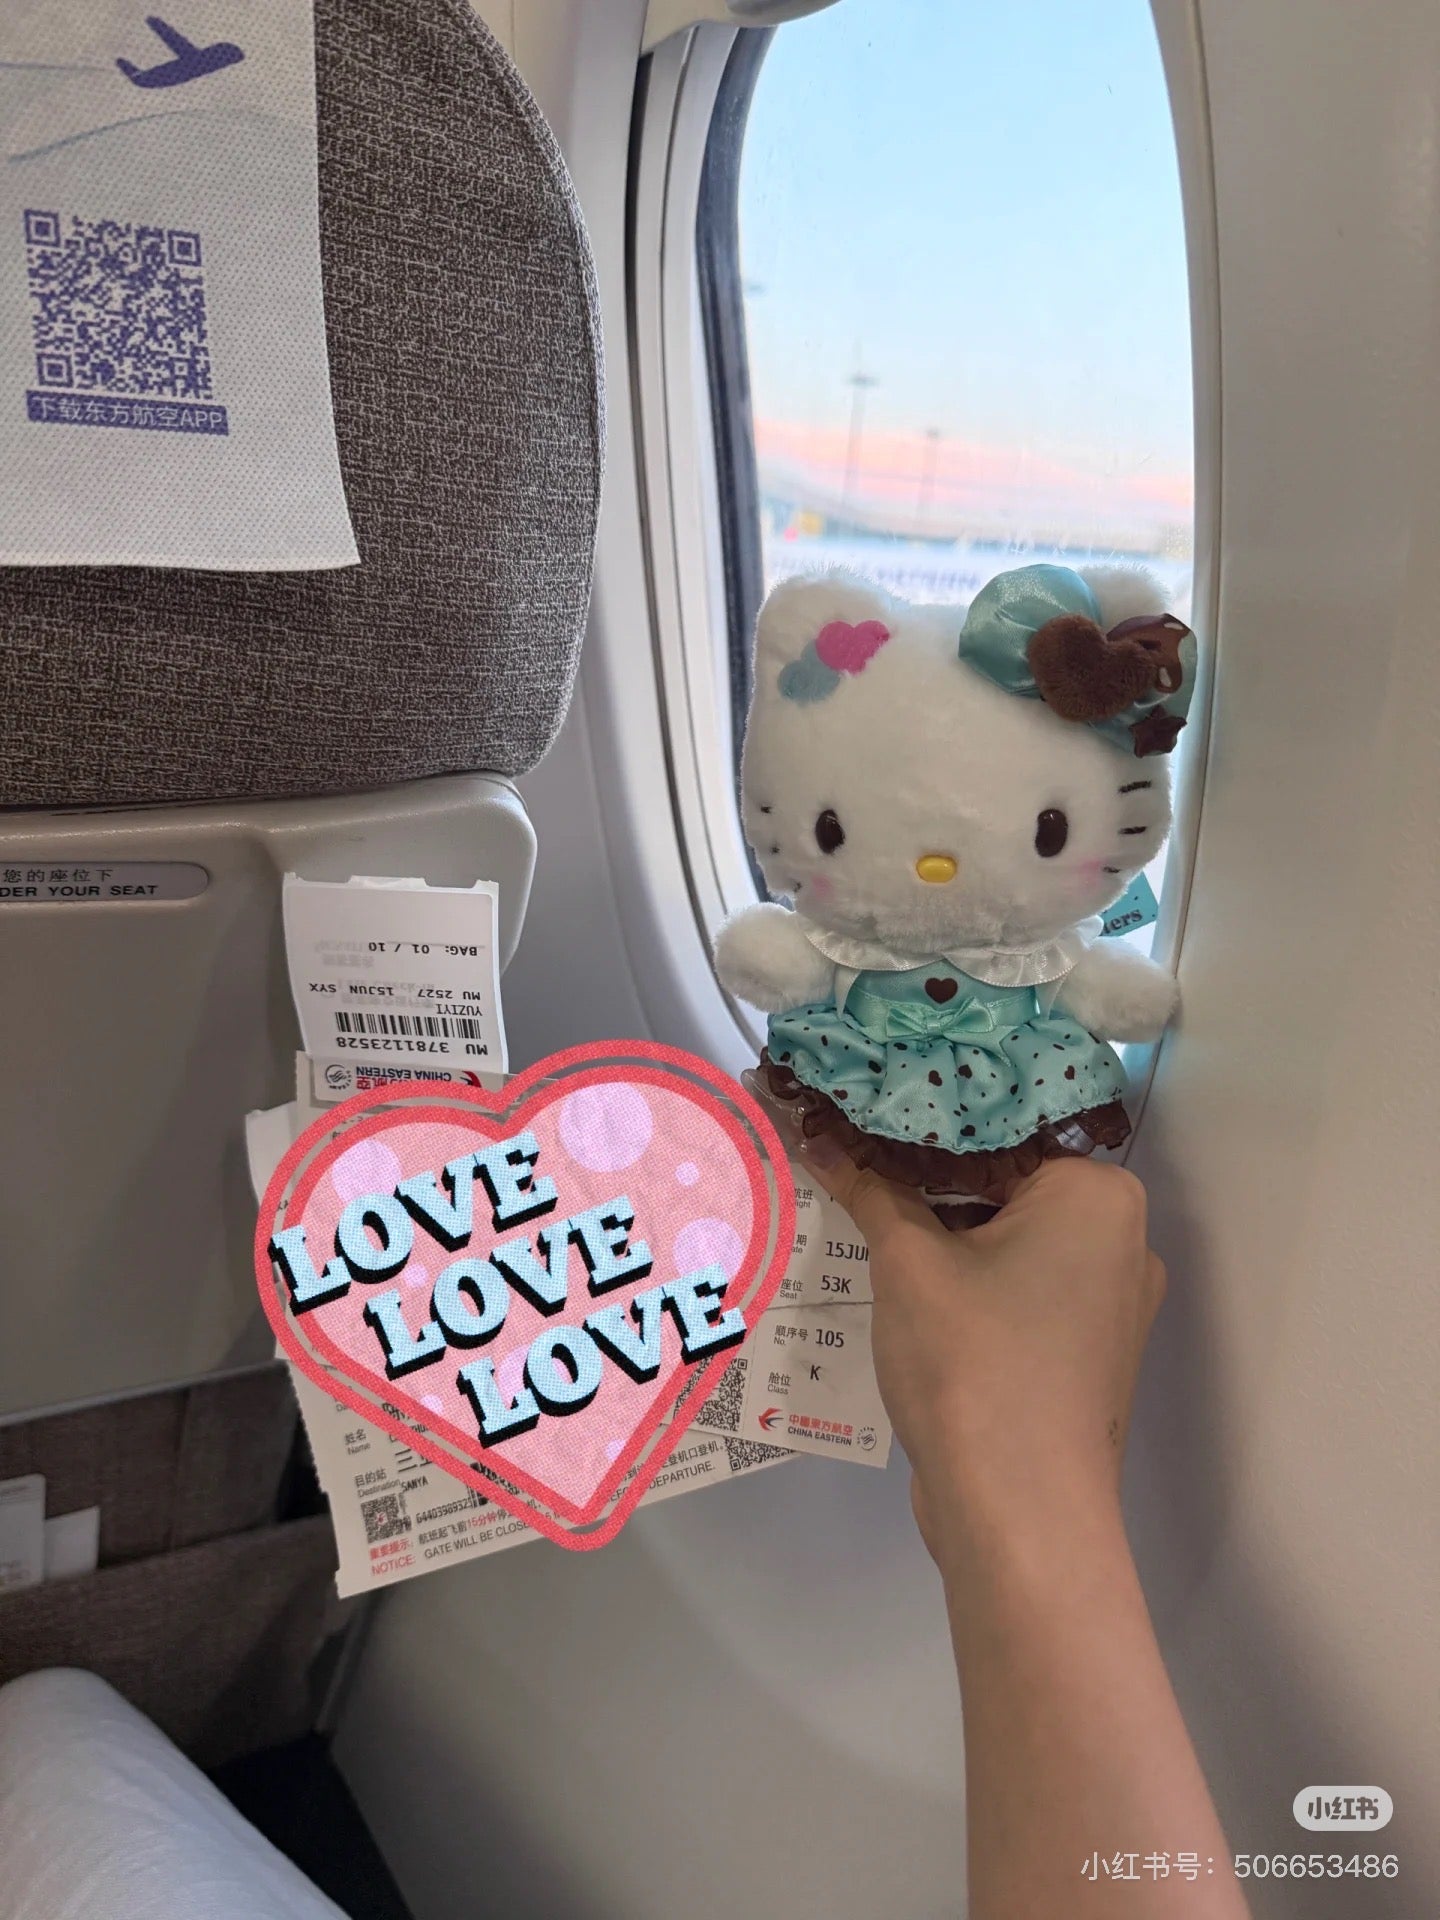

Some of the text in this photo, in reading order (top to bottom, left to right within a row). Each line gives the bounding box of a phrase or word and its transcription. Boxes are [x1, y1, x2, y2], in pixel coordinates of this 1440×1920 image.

[33, 397, 222, 428] 下载东方航空APP
[3, 868, 113, 884] 您的座位下
[49, 886, 100, 897] YOUR
[110, 885, 158, 896] SEAT
[368, 942, 386, 952] 10
[412, 944, 430, 954] 01
[445, 945, 478, 957] BAG:
[309, 983, 481, 1001] MU 2527 15JUN SYX
[436, 1003, 482, 1017] YUZIYI
[336, 1037, 489, 1056] MU 3781123528
[356, 1066, 452, 1082] CHINA EASTERN
[781, 1279, 803, 1292] 座位
[821, 1275, 852, 1294] 53K
[780, 1290, 797, 1299] Seat
[775, 1325, 808, 1341] 顺序号
[815, 1329, 845, 1348] 105
[768, 1372, 791, 1387] 舱位
[810, 1364, 821, 1381] K
[767, 1384, 789, 1395] Class
[344, 1428, 366, 1445] 姓名
[788, 1426, 813, 1439] CHINA
[815, 1431, 852, 1446] EASTERN
[347, 1442, 370, 1455] Name
[354, 1467, 387, 1488] 目的站
[402, 1475, 429, 1493] SANYA
[357, 1479, 401, 1498] Destination
[424, 1542, 453, 1559] GATE
[454, 1535, 478, 1550] WILL
[480, 1531, 494, 1542] BE
